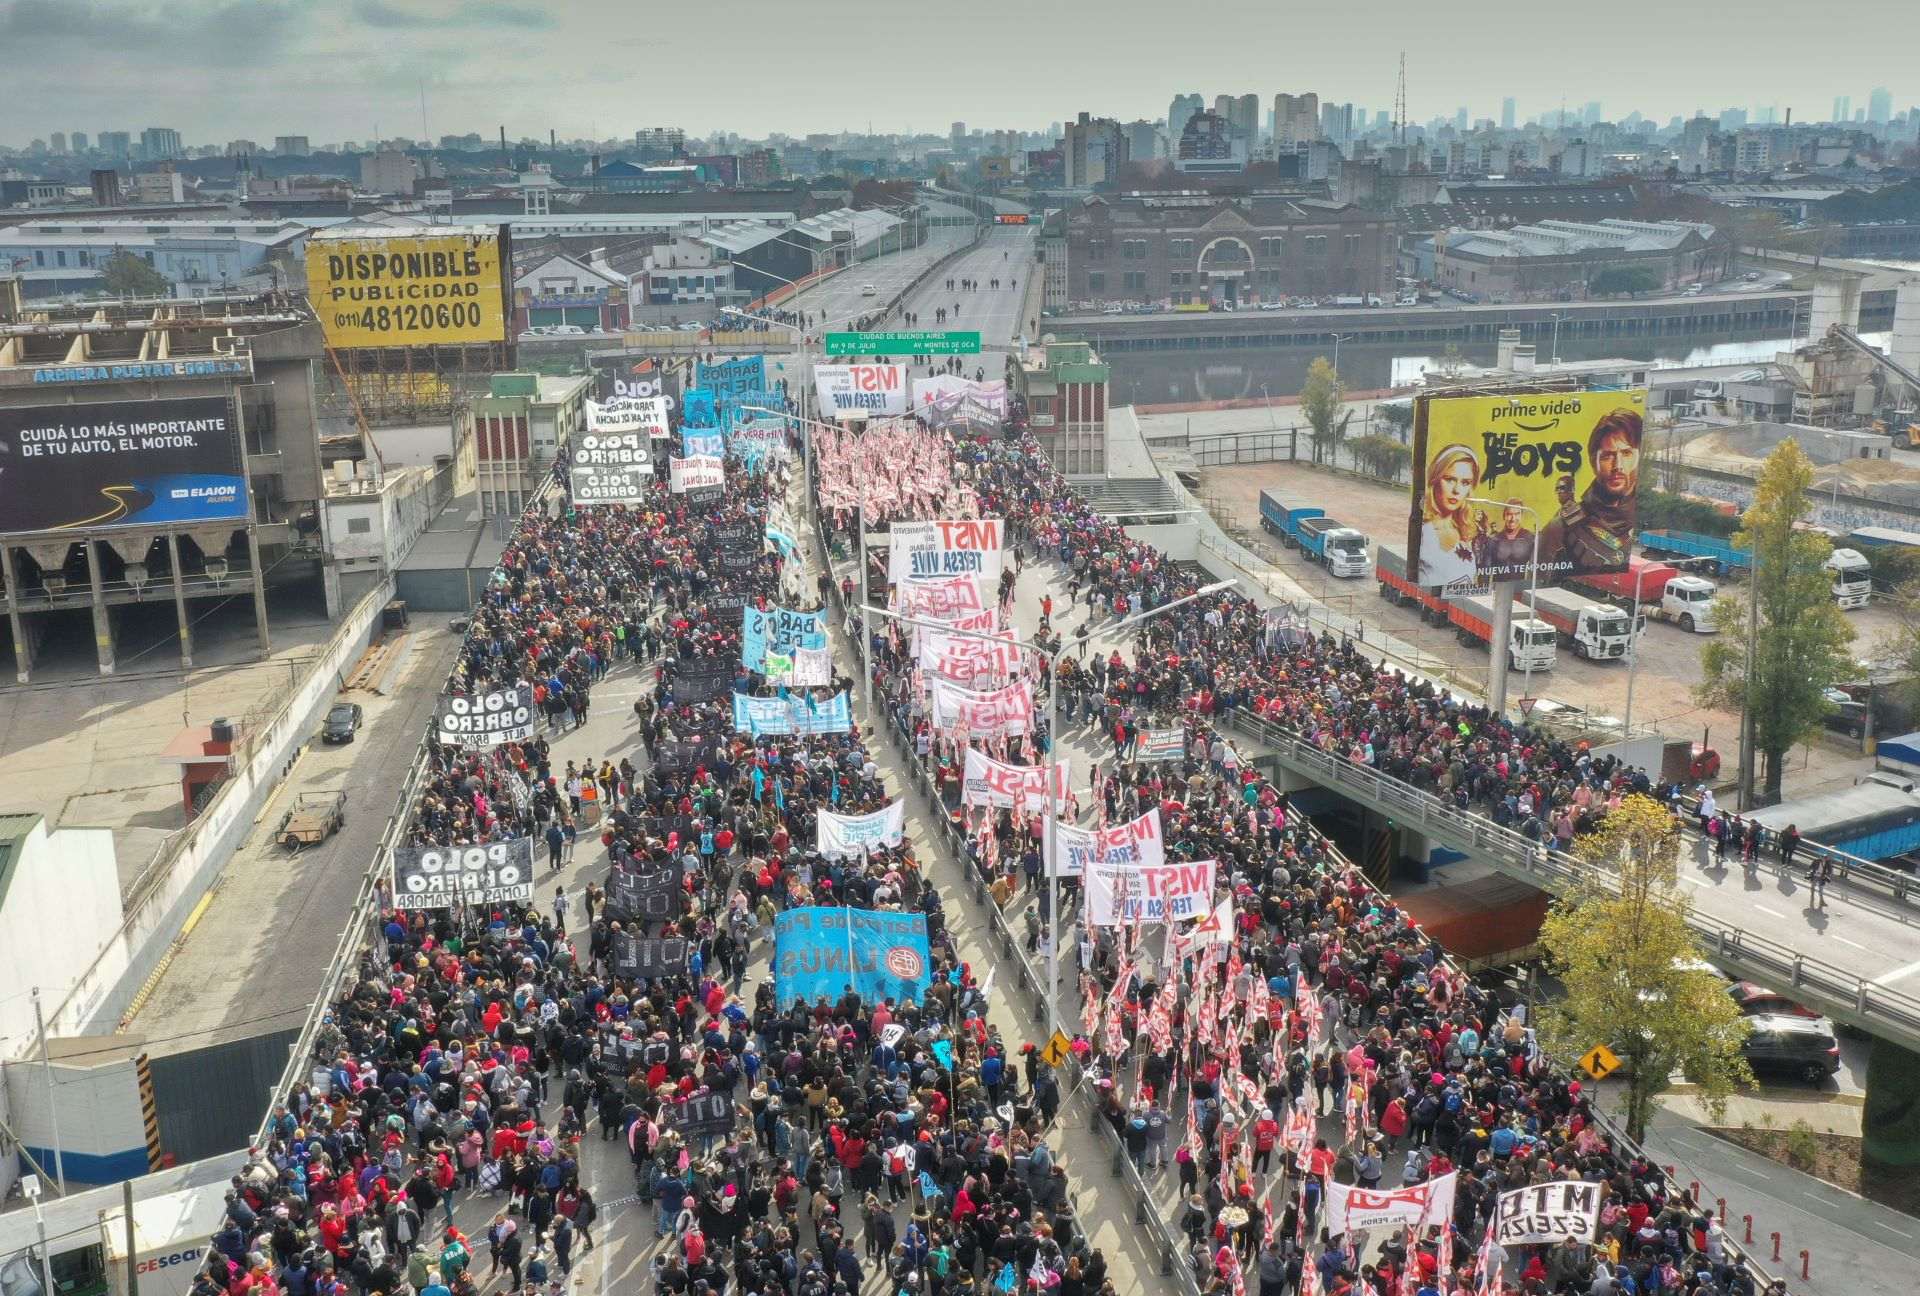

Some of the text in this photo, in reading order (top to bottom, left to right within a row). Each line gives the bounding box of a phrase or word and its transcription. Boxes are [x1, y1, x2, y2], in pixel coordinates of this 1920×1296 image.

[329, 251, 480, 280] DISPONIBLE
[1491, 400, 1581, 421] prime video
[20, 418, 226, 442] CUIDÁ LO MÁS IMPORTANTE
[1482, 431, 1518, 448] THE
[22, 435, 198, 457] DE TU AUTO, EL MOTOR.
[1481, 440, 1582, 480] BOYS
[191, 486, 236, 497] ELAION
[1478, 561, 1573, 576] NUEVA TEMPORADA
